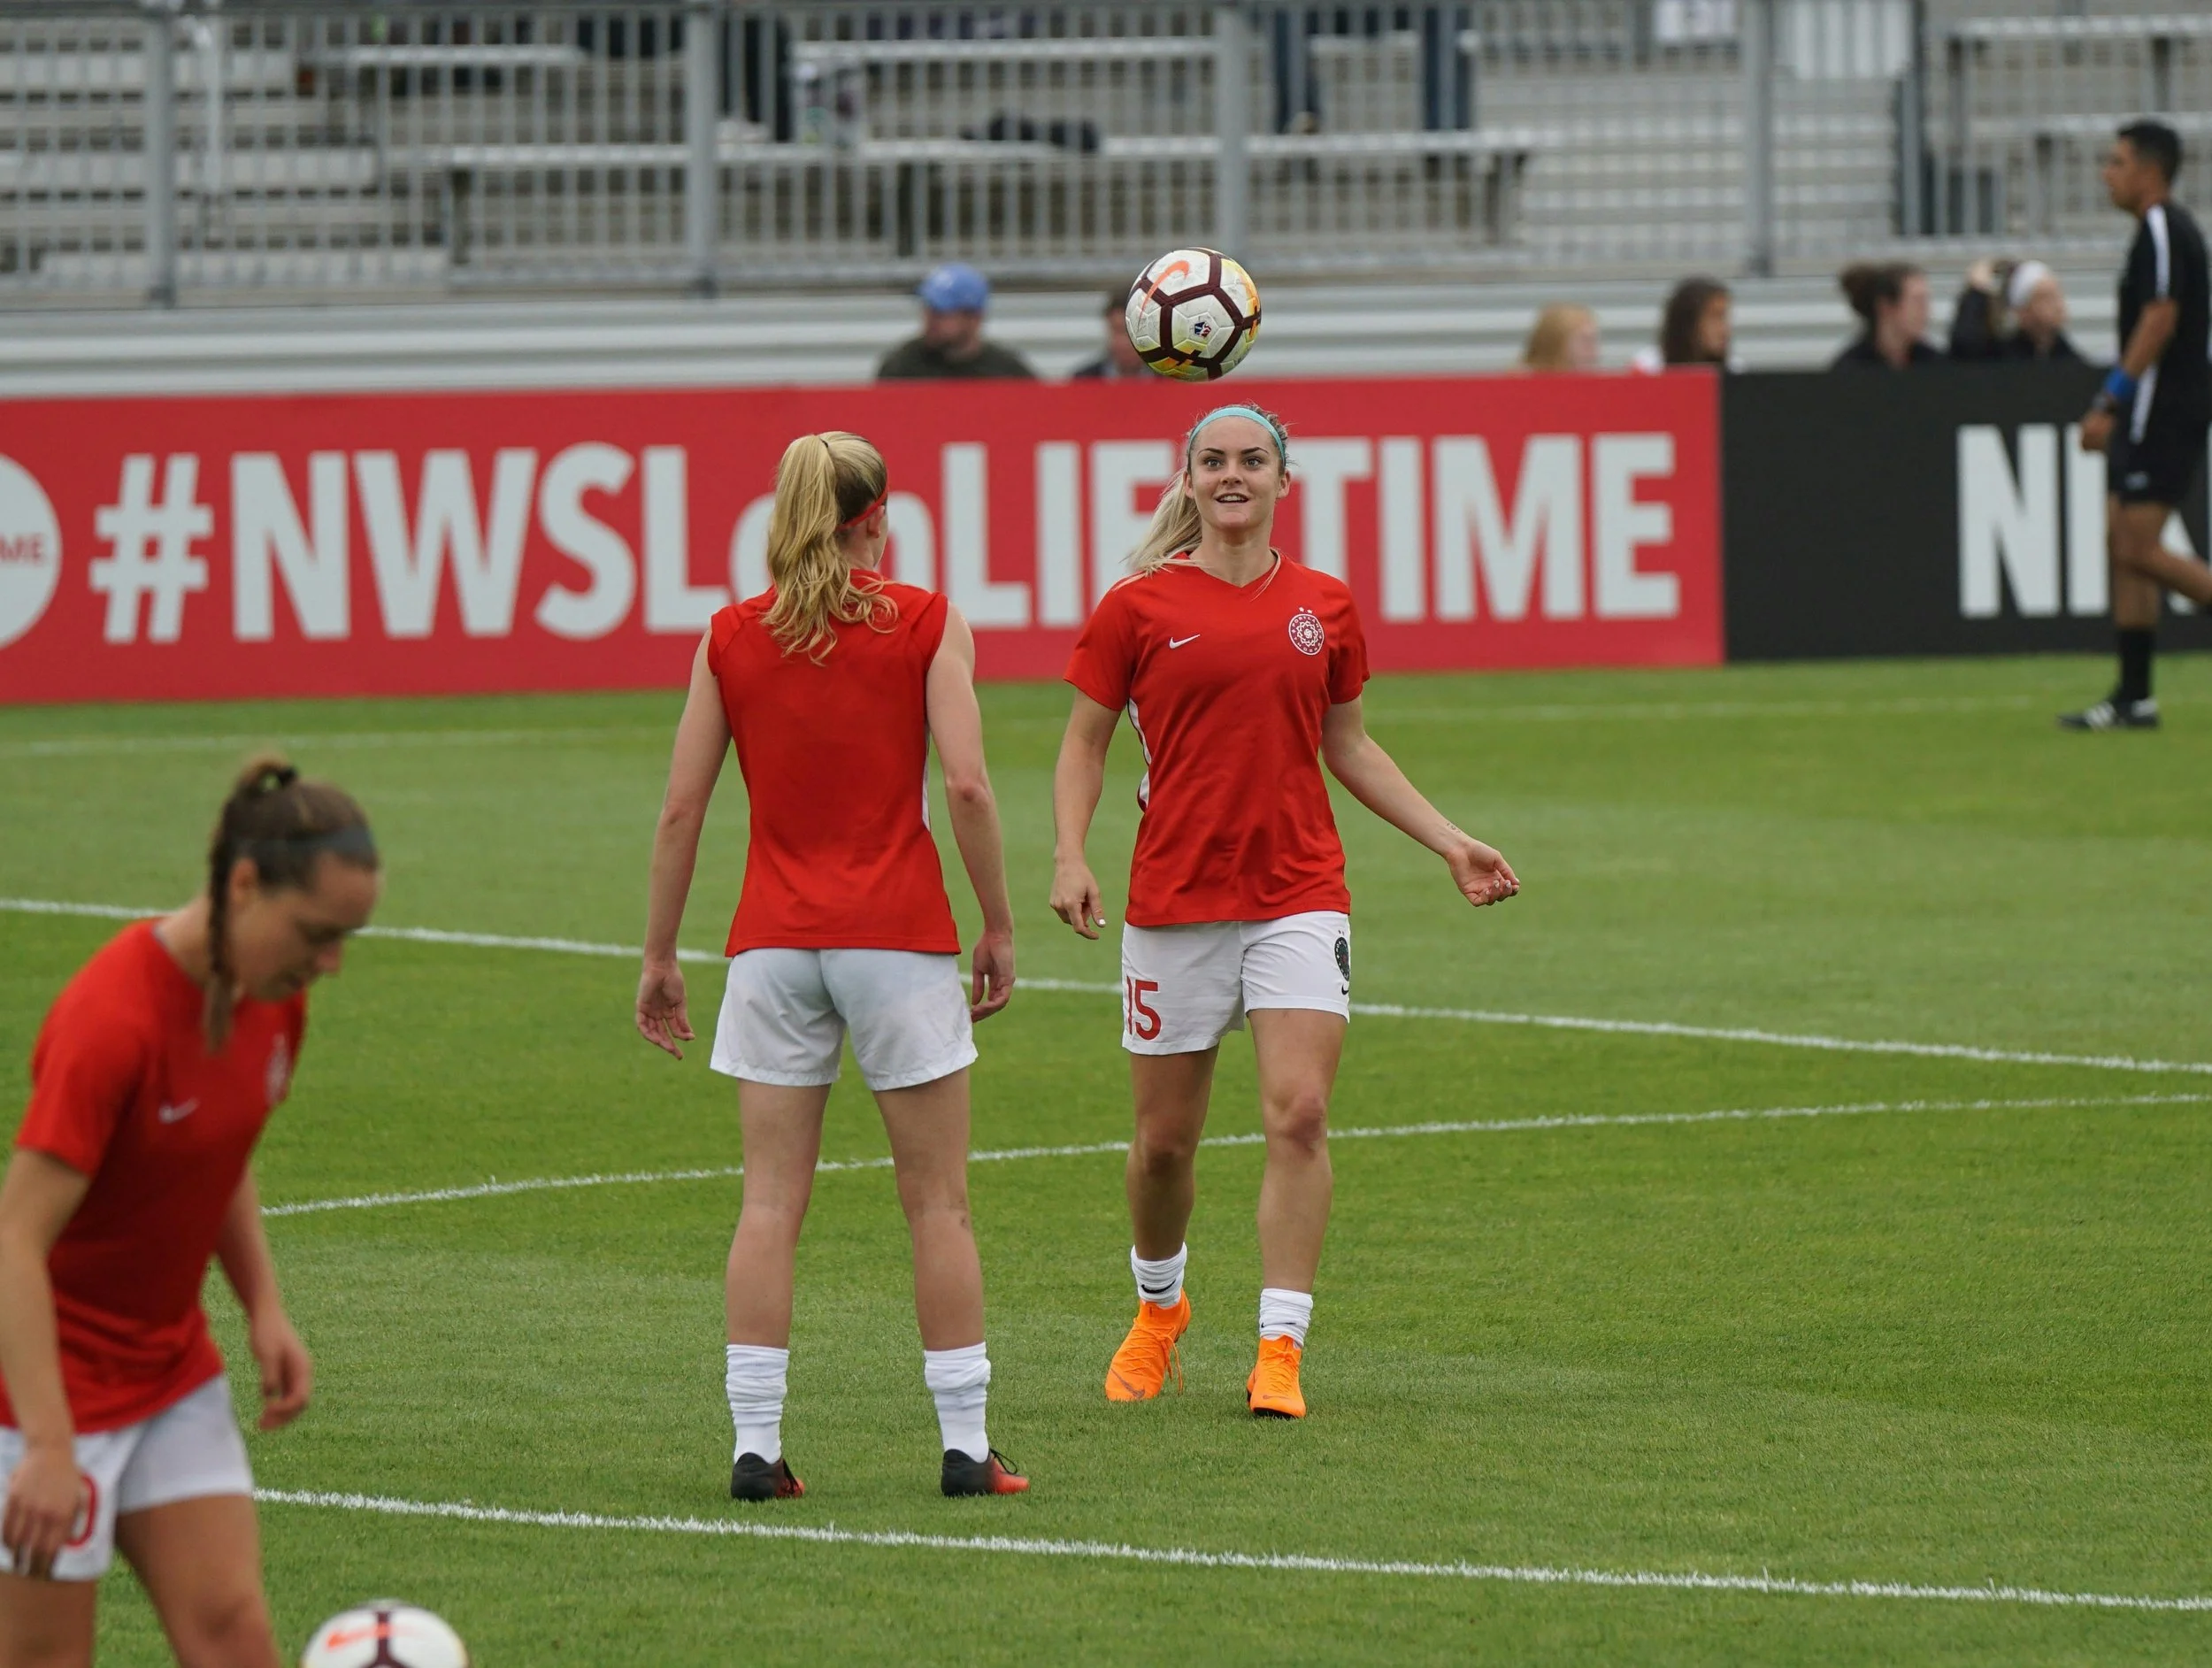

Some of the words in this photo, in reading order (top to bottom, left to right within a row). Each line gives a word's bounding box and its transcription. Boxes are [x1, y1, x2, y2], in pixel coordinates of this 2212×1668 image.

[89, 430, 1679, 642] #NWSLLIFTIME
[1956, 422, 2212, 617] NI
[1125, 974, 1162, 1041] 15
